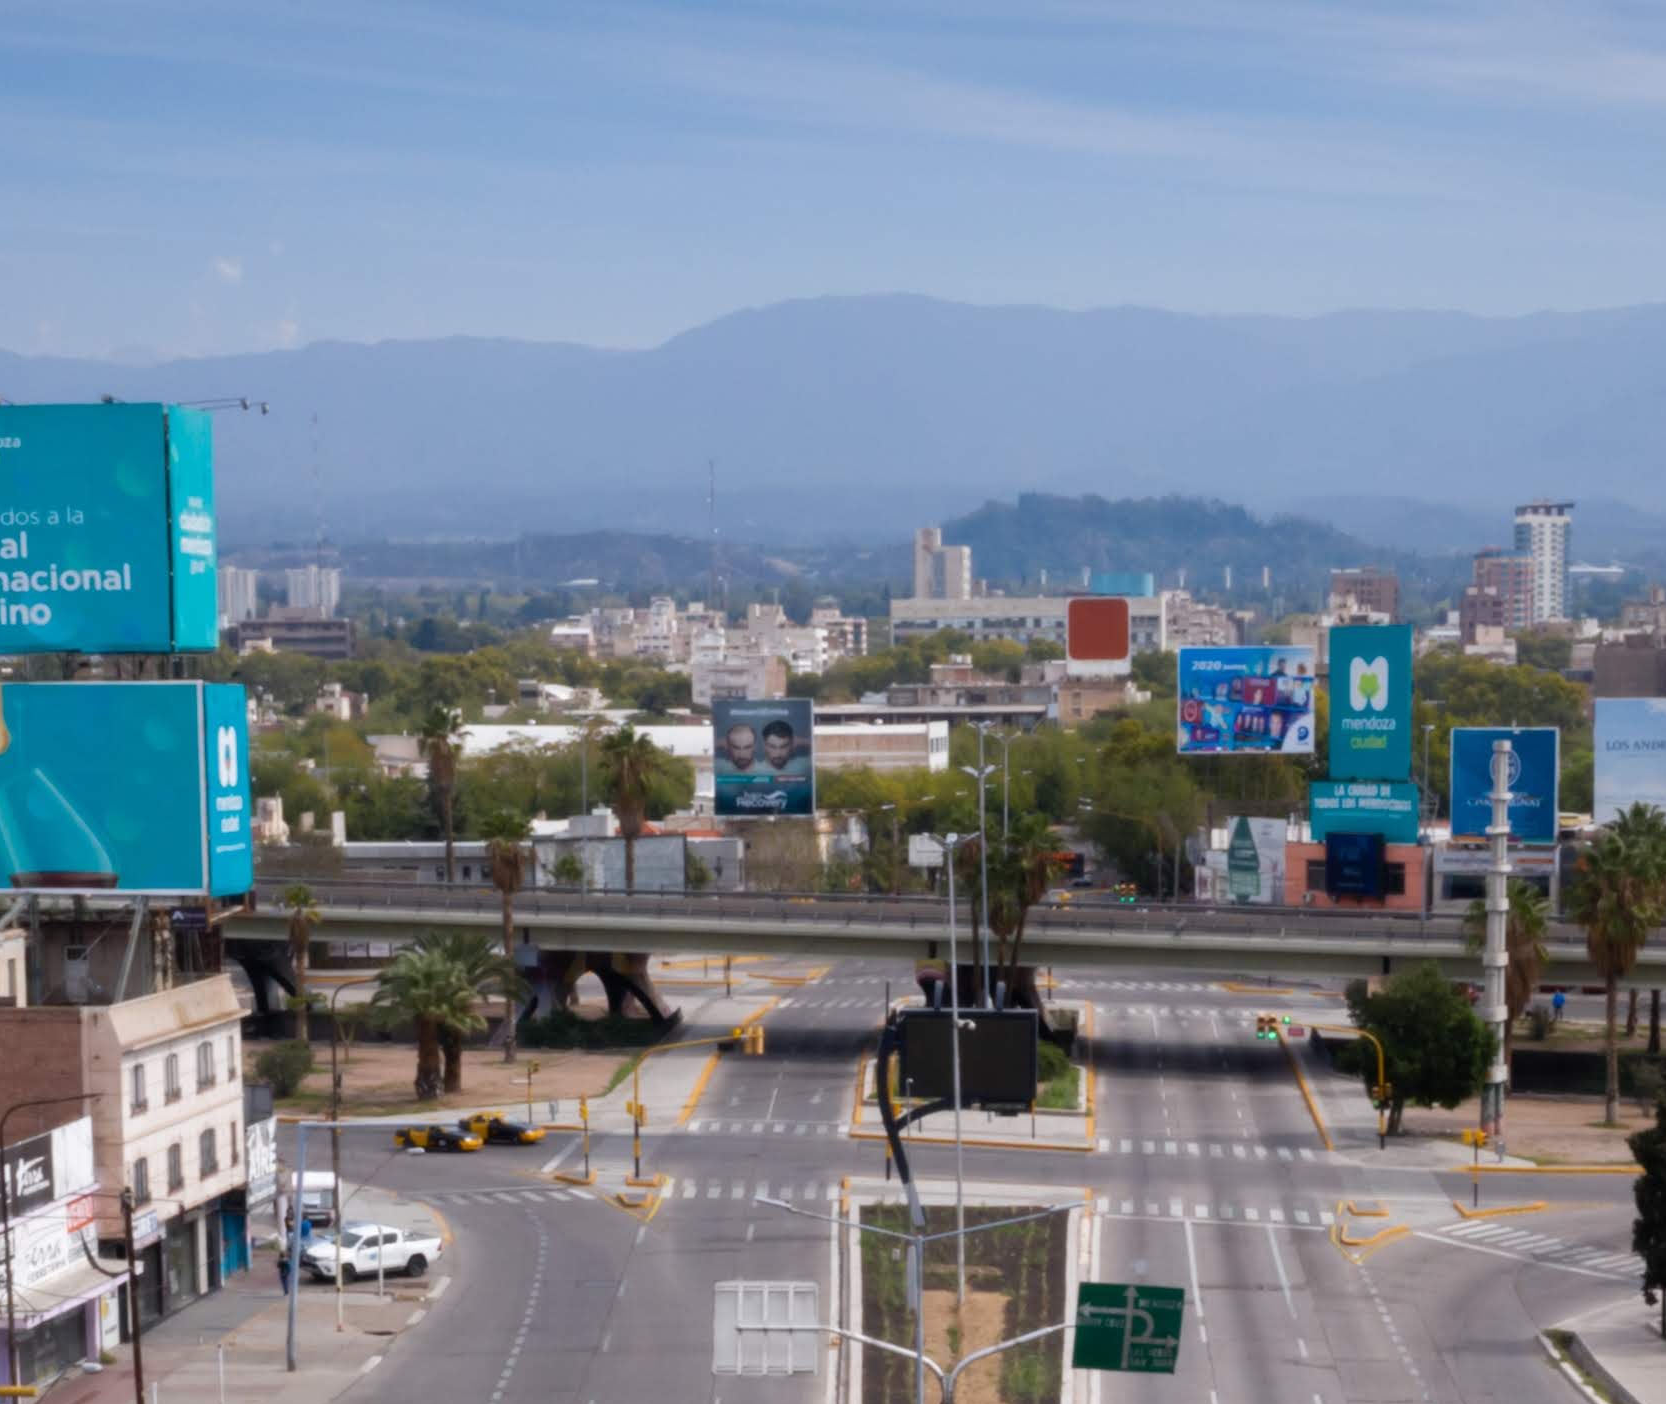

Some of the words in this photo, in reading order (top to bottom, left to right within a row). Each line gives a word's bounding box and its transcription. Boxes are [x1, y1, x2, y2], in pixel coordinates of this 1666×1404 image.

[47, 511, 60, 525] a
[67, 506, 84, 525] la
[1341, 715, 1397, 731] mendoza
[1605, 740, 1630, 752] LOS
